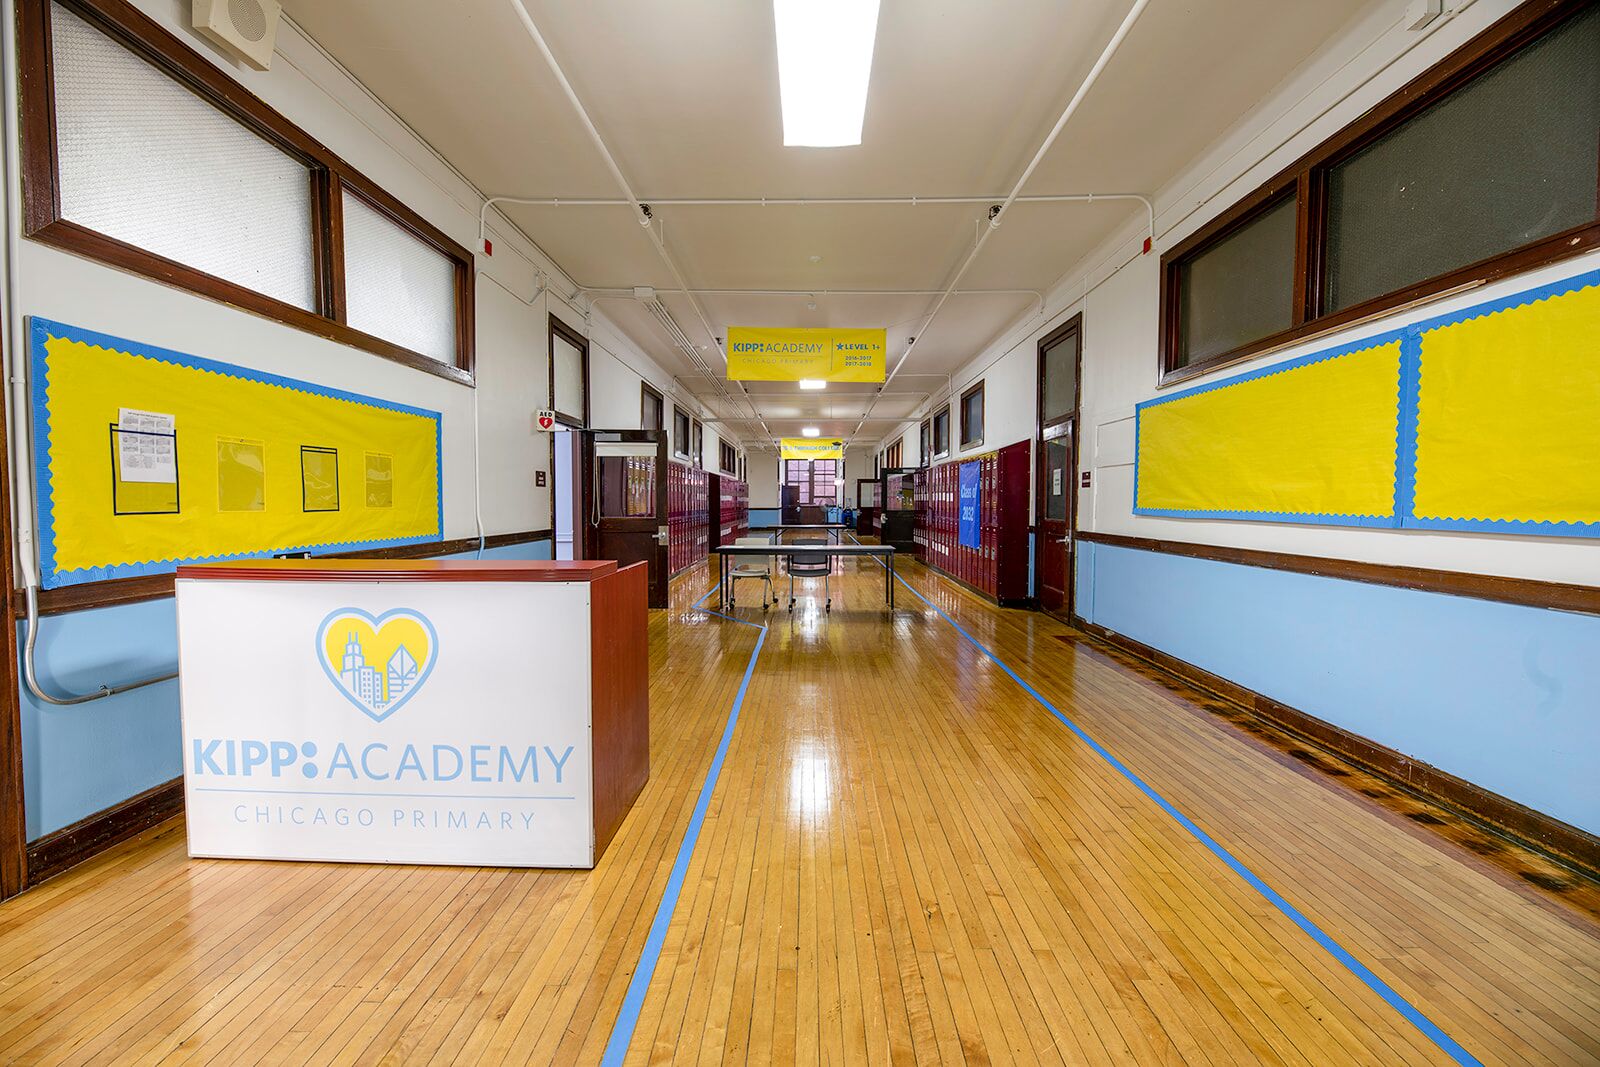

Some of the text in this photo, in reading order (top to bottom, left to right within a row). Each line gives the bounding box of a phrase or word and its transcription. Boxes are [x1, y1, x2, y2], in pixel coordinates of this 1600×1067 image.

[765, 343, 824, 353] ACADEMY
[961, 482, 978, 498] Class of
[326, 742, 575, 784] ACADEMY
[234, 805, 536, 830] CHICAGO PRIMARY
